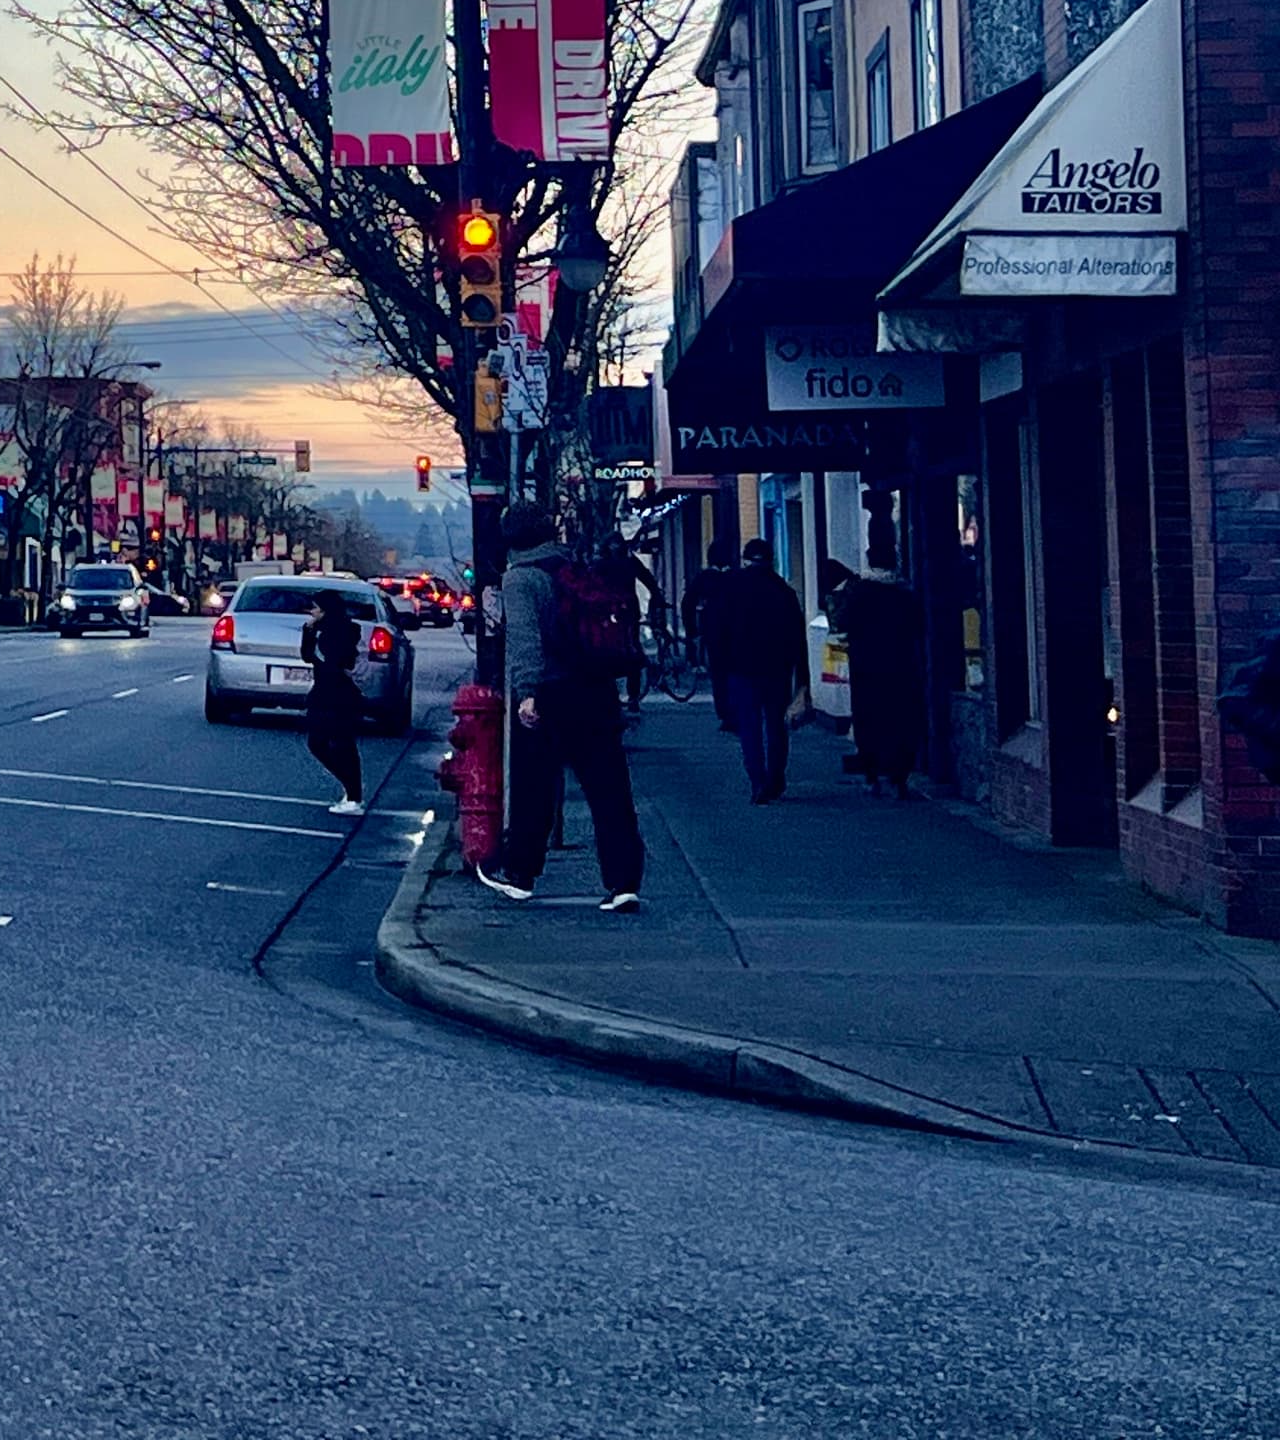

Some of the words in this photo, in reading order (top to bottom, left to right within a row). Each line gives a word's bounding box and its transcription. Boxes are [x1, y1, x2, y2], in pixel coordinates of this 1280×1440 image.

[339, 34, 441, 96] italy
[1025, 148, 1160, 198] Angelo
[1030, 193, 1153, 213] TAILORS
[964, 256, 1073, 278] Professional
[1077, 255, 1177, 277] Alterations
[811, 336, 872, 358] ROG
[805, 366, 874, 398] fido
